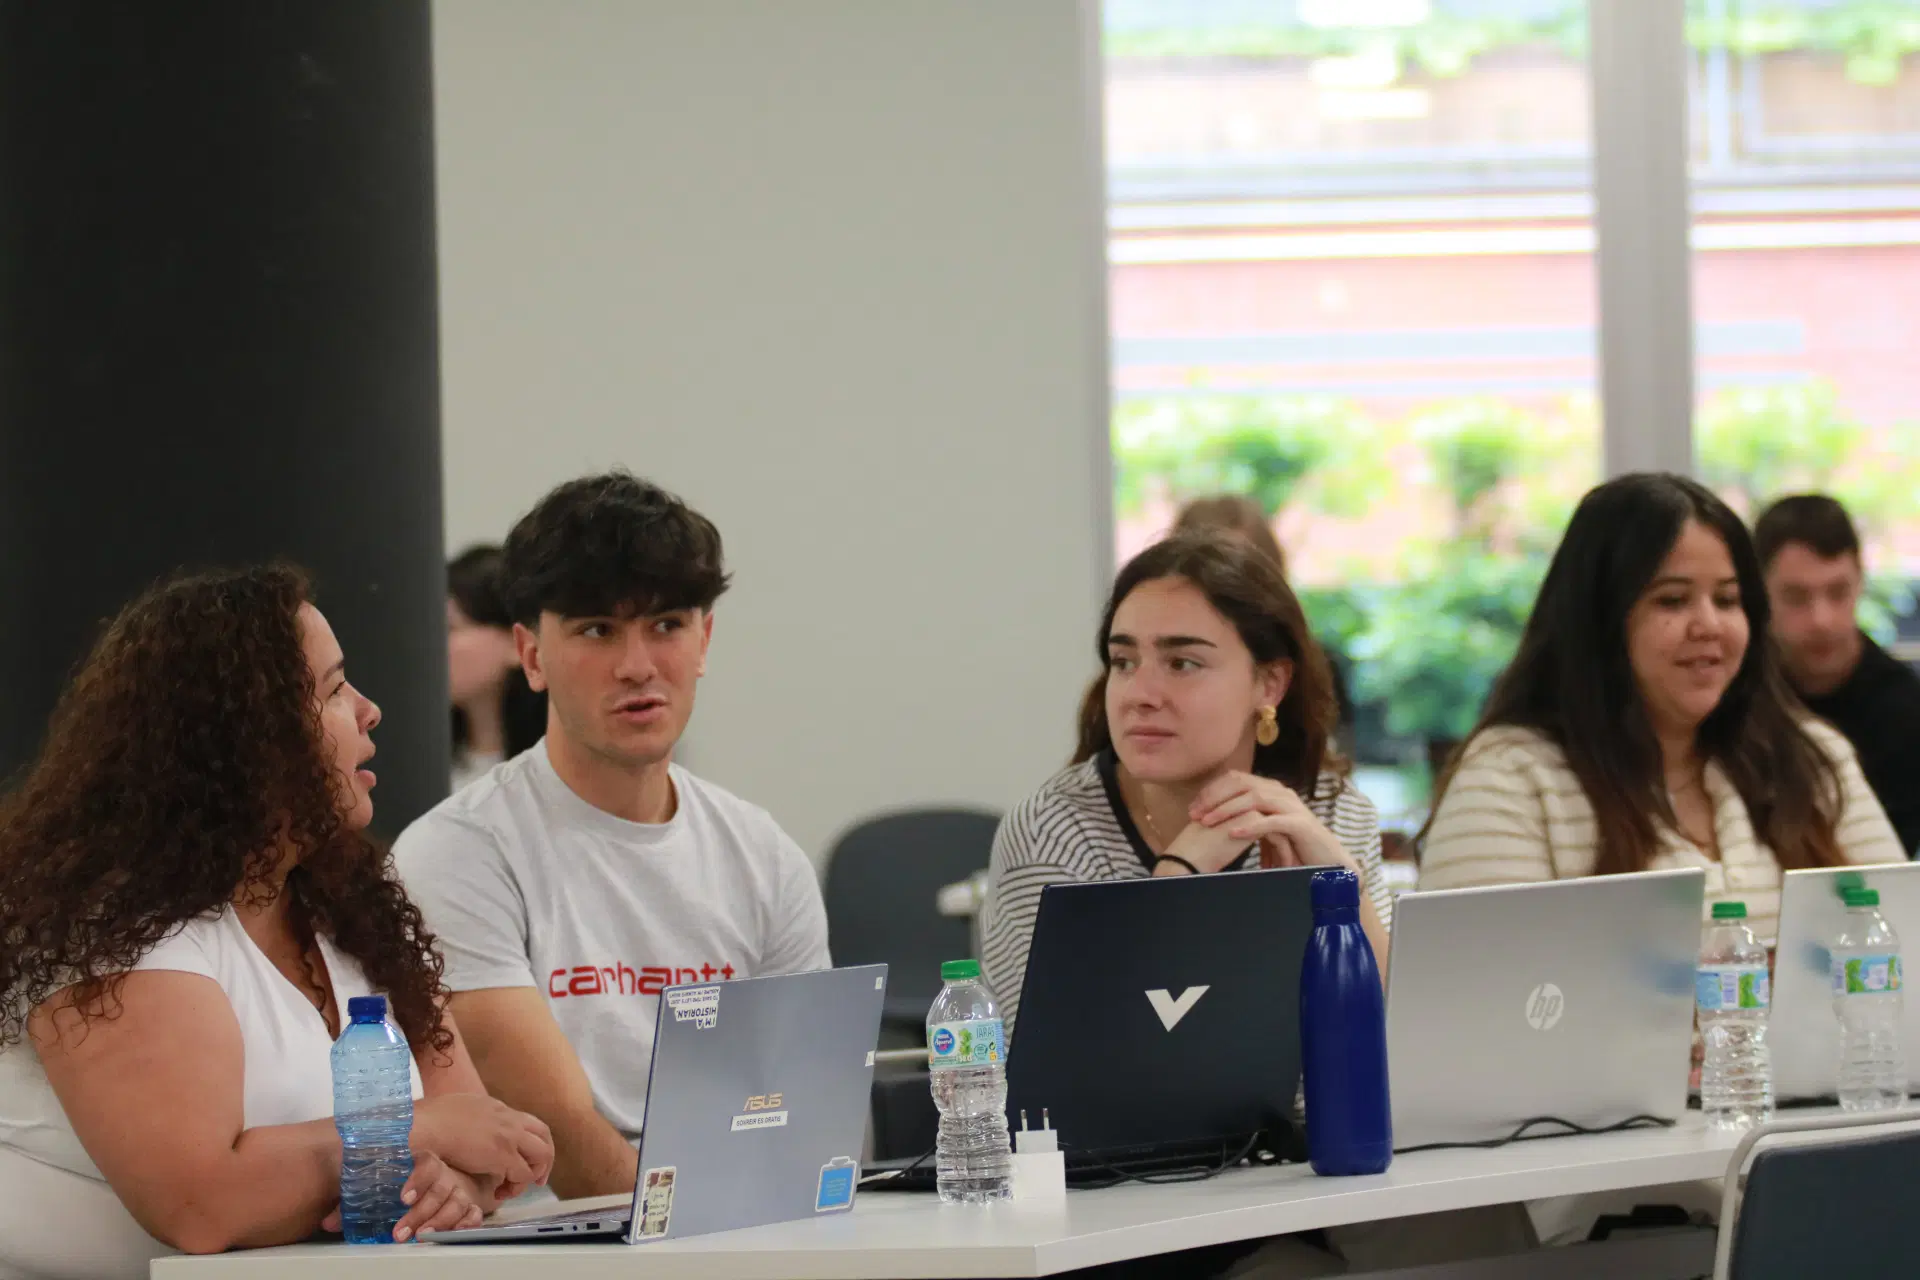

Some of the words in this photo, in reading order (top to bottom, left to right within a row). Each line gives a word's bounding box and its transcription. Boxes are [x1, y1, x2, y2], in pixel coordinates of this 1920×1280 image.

[549, 961, 735, 998] carhartt
[1528, 984, 1563, 1029] hp
[743, 1092, 783, 1112] ASUS
